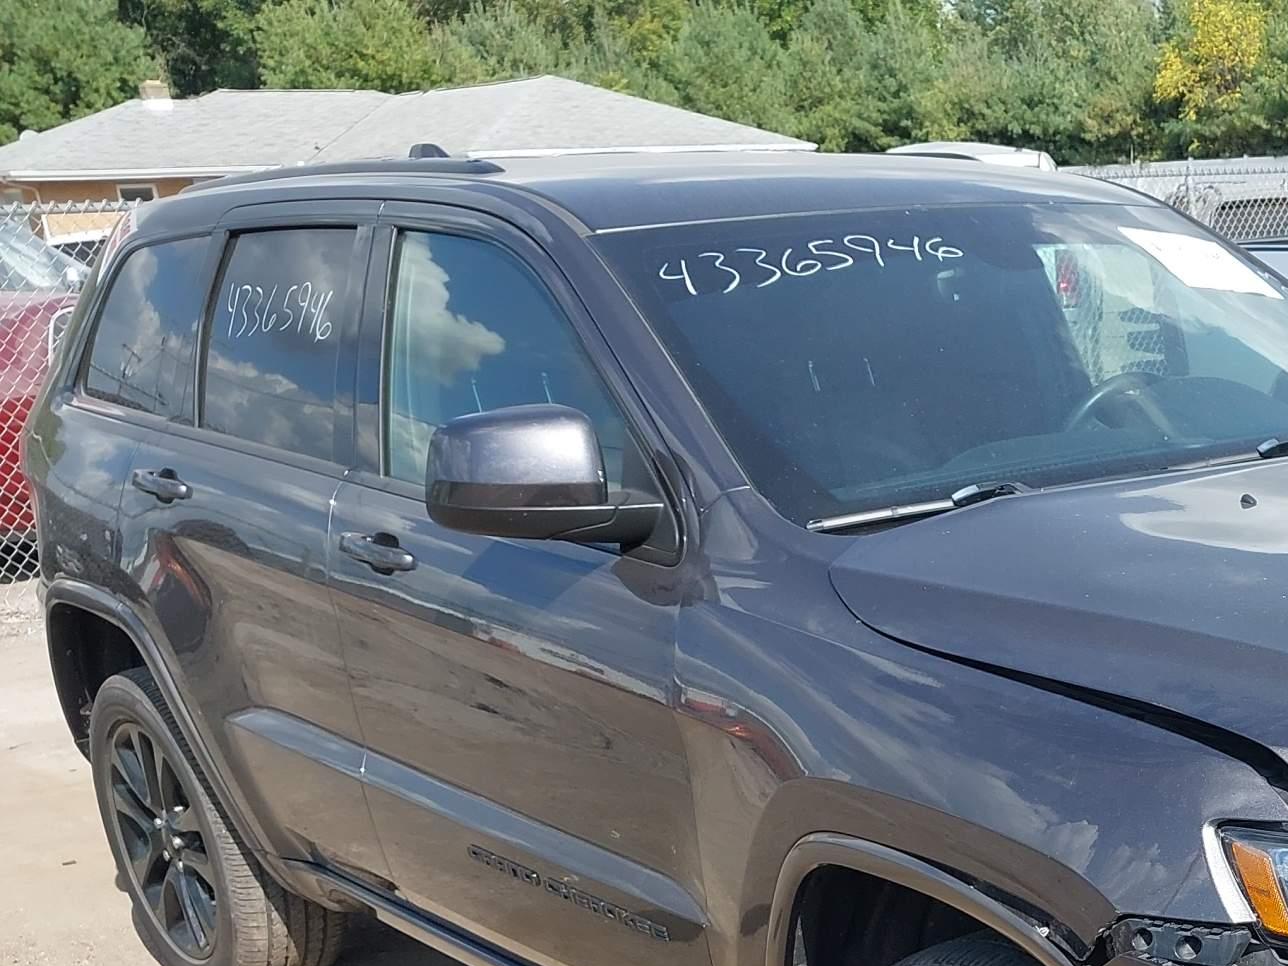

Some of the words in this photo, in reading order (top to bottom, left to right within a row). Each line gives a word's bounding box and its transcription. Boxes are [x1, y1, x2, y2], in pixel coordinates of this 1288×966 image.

[658, 234, 965, 296] 43365946
[227, 281, 334, 344] 43365946
[466, 843, 542, 888] GRAND
[543, 876, 672, 943] CHEROKEE
